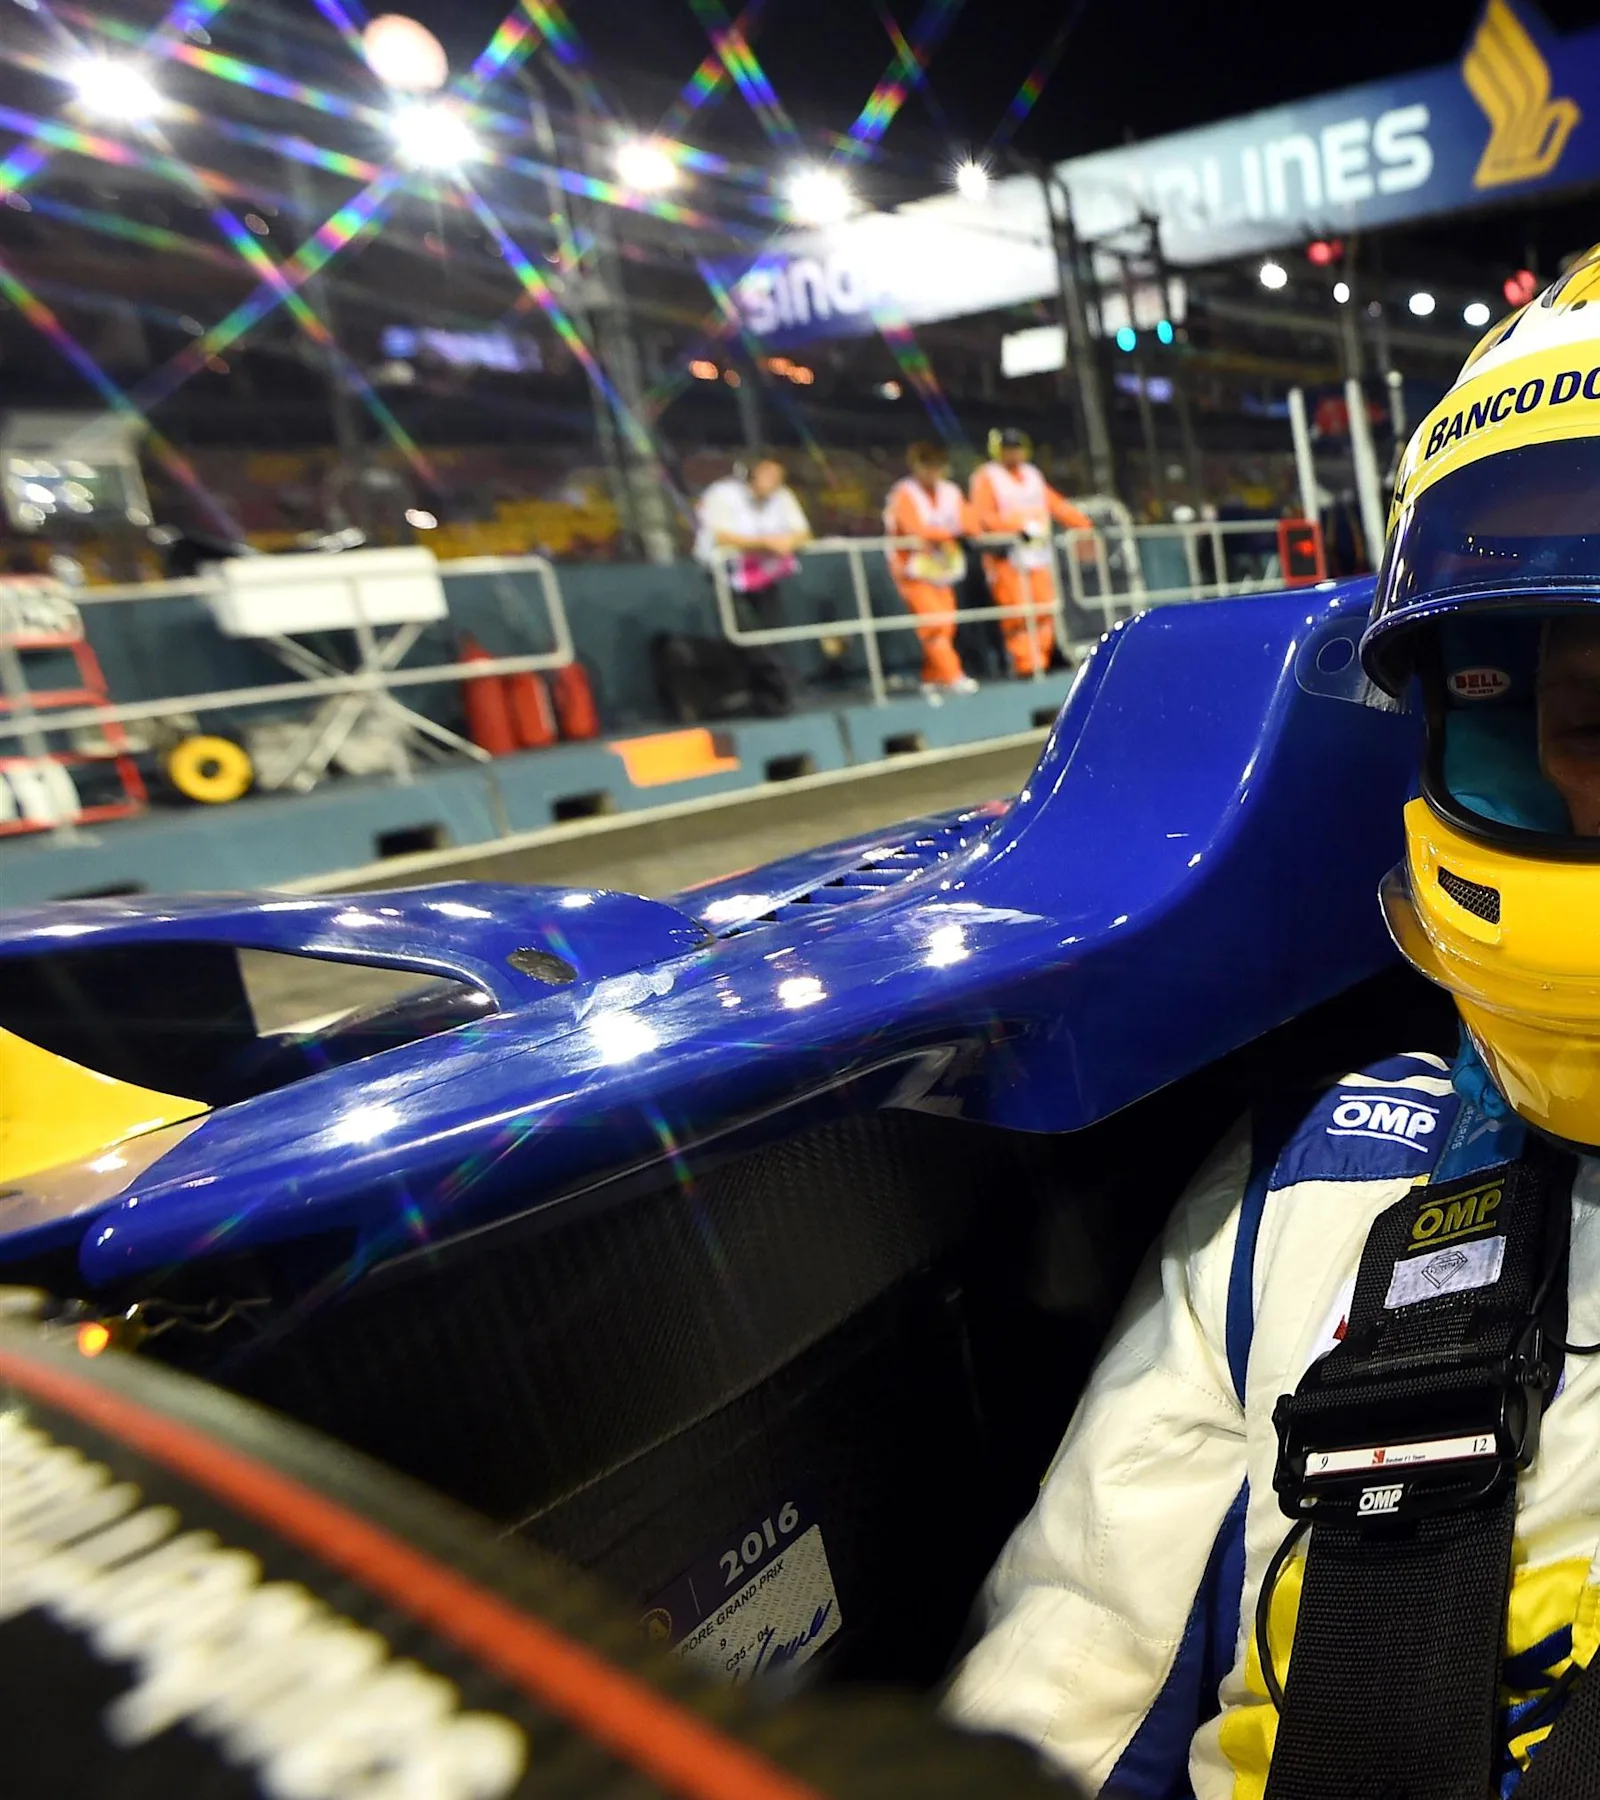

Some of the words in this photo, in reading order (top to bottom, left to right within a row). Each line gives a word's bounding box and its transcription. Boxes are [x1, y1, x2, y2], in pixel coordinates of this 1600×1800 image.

[1426, 379, 1544, 459] BANCO
[1455, 673, 1503, 688] BELL
[1332, 1101, 1437, 1140] OMP
[1411, 1188, 1502, 1241] OMP
[1472, 1438, 1488, 1453] 12
[1320, 1455, 1329, 1470] 9
[1359, 1489, 1403, 1511] OMP
[719, 1502, 799, 1587] 2016
[716, 1583, 757, 1626] GRAND
[759, 1560, 785, 1590] PRIX
[720, 1638, 727, 1650] 9
[726, 1647, 746, 1671] C35
